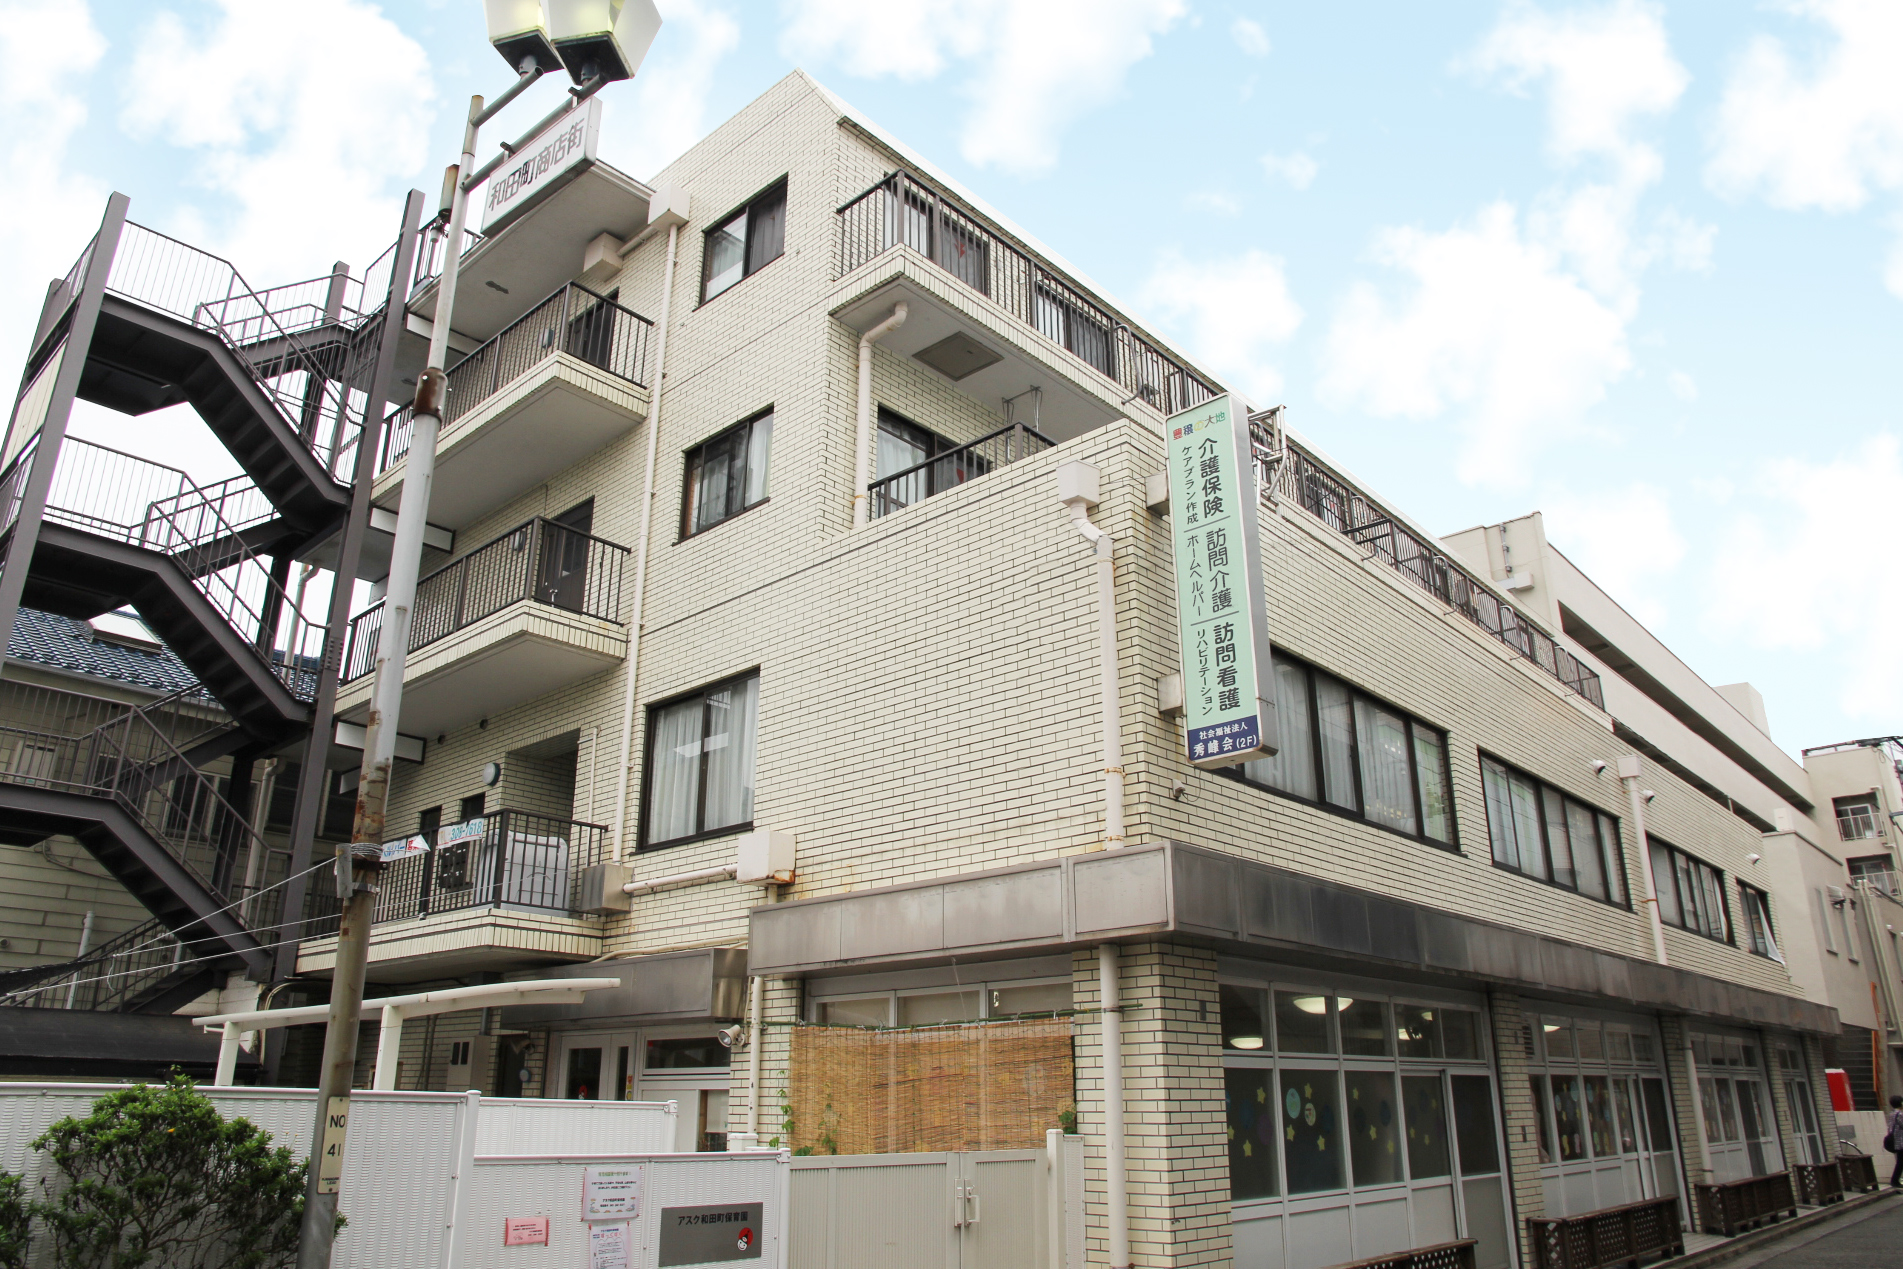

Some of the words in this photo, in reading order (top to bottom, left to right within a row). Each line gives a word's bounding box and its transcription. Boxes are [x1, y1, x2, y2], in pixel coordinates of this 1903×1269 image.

[489, 118, 585, 211] 和田町商店街
[1182, 446, 1199, 525] ケアプラン作成
[1198, 437, 1224, 518] 介護保険
[1187, 535, 1204, 616] ホームヘルパー
[1206, 528, 1232, 613] 訪問介護
[1197, 629, 1212, 716] リハビリテーション
[1213, 622, 1240, 712] 訪問看護
[1199, 722, 1248, 740] 社会福祉法人
[327, 1143, 341, 1156] 41
[330, 1115, 345, 1128] NO
[678, 1211, 748, 1226] アスク和田町保育園
